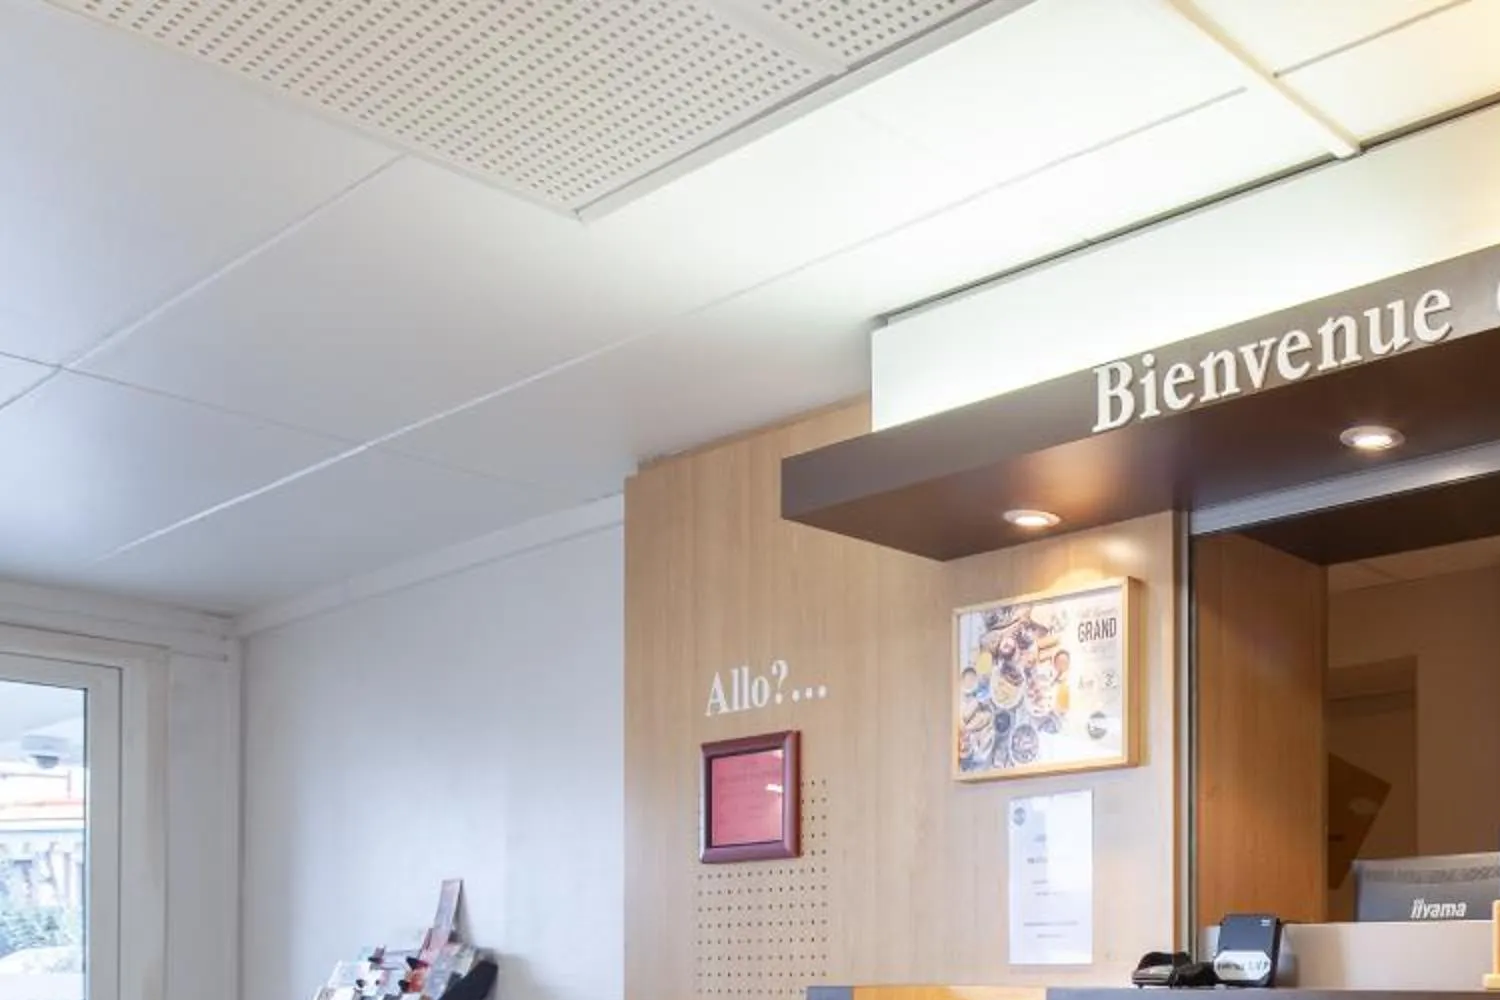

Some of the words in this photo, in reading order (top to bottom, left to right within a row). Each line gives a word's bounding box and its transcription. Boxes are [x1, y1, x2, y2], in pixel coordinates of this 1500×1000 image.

[1092, 288, 1454, 434] Bienvenue
[1077, 617, 1118, 643] GRAND
[704, 659, 828, 717] Allo?...
[1410, 898, 1467, 919] iiyama
